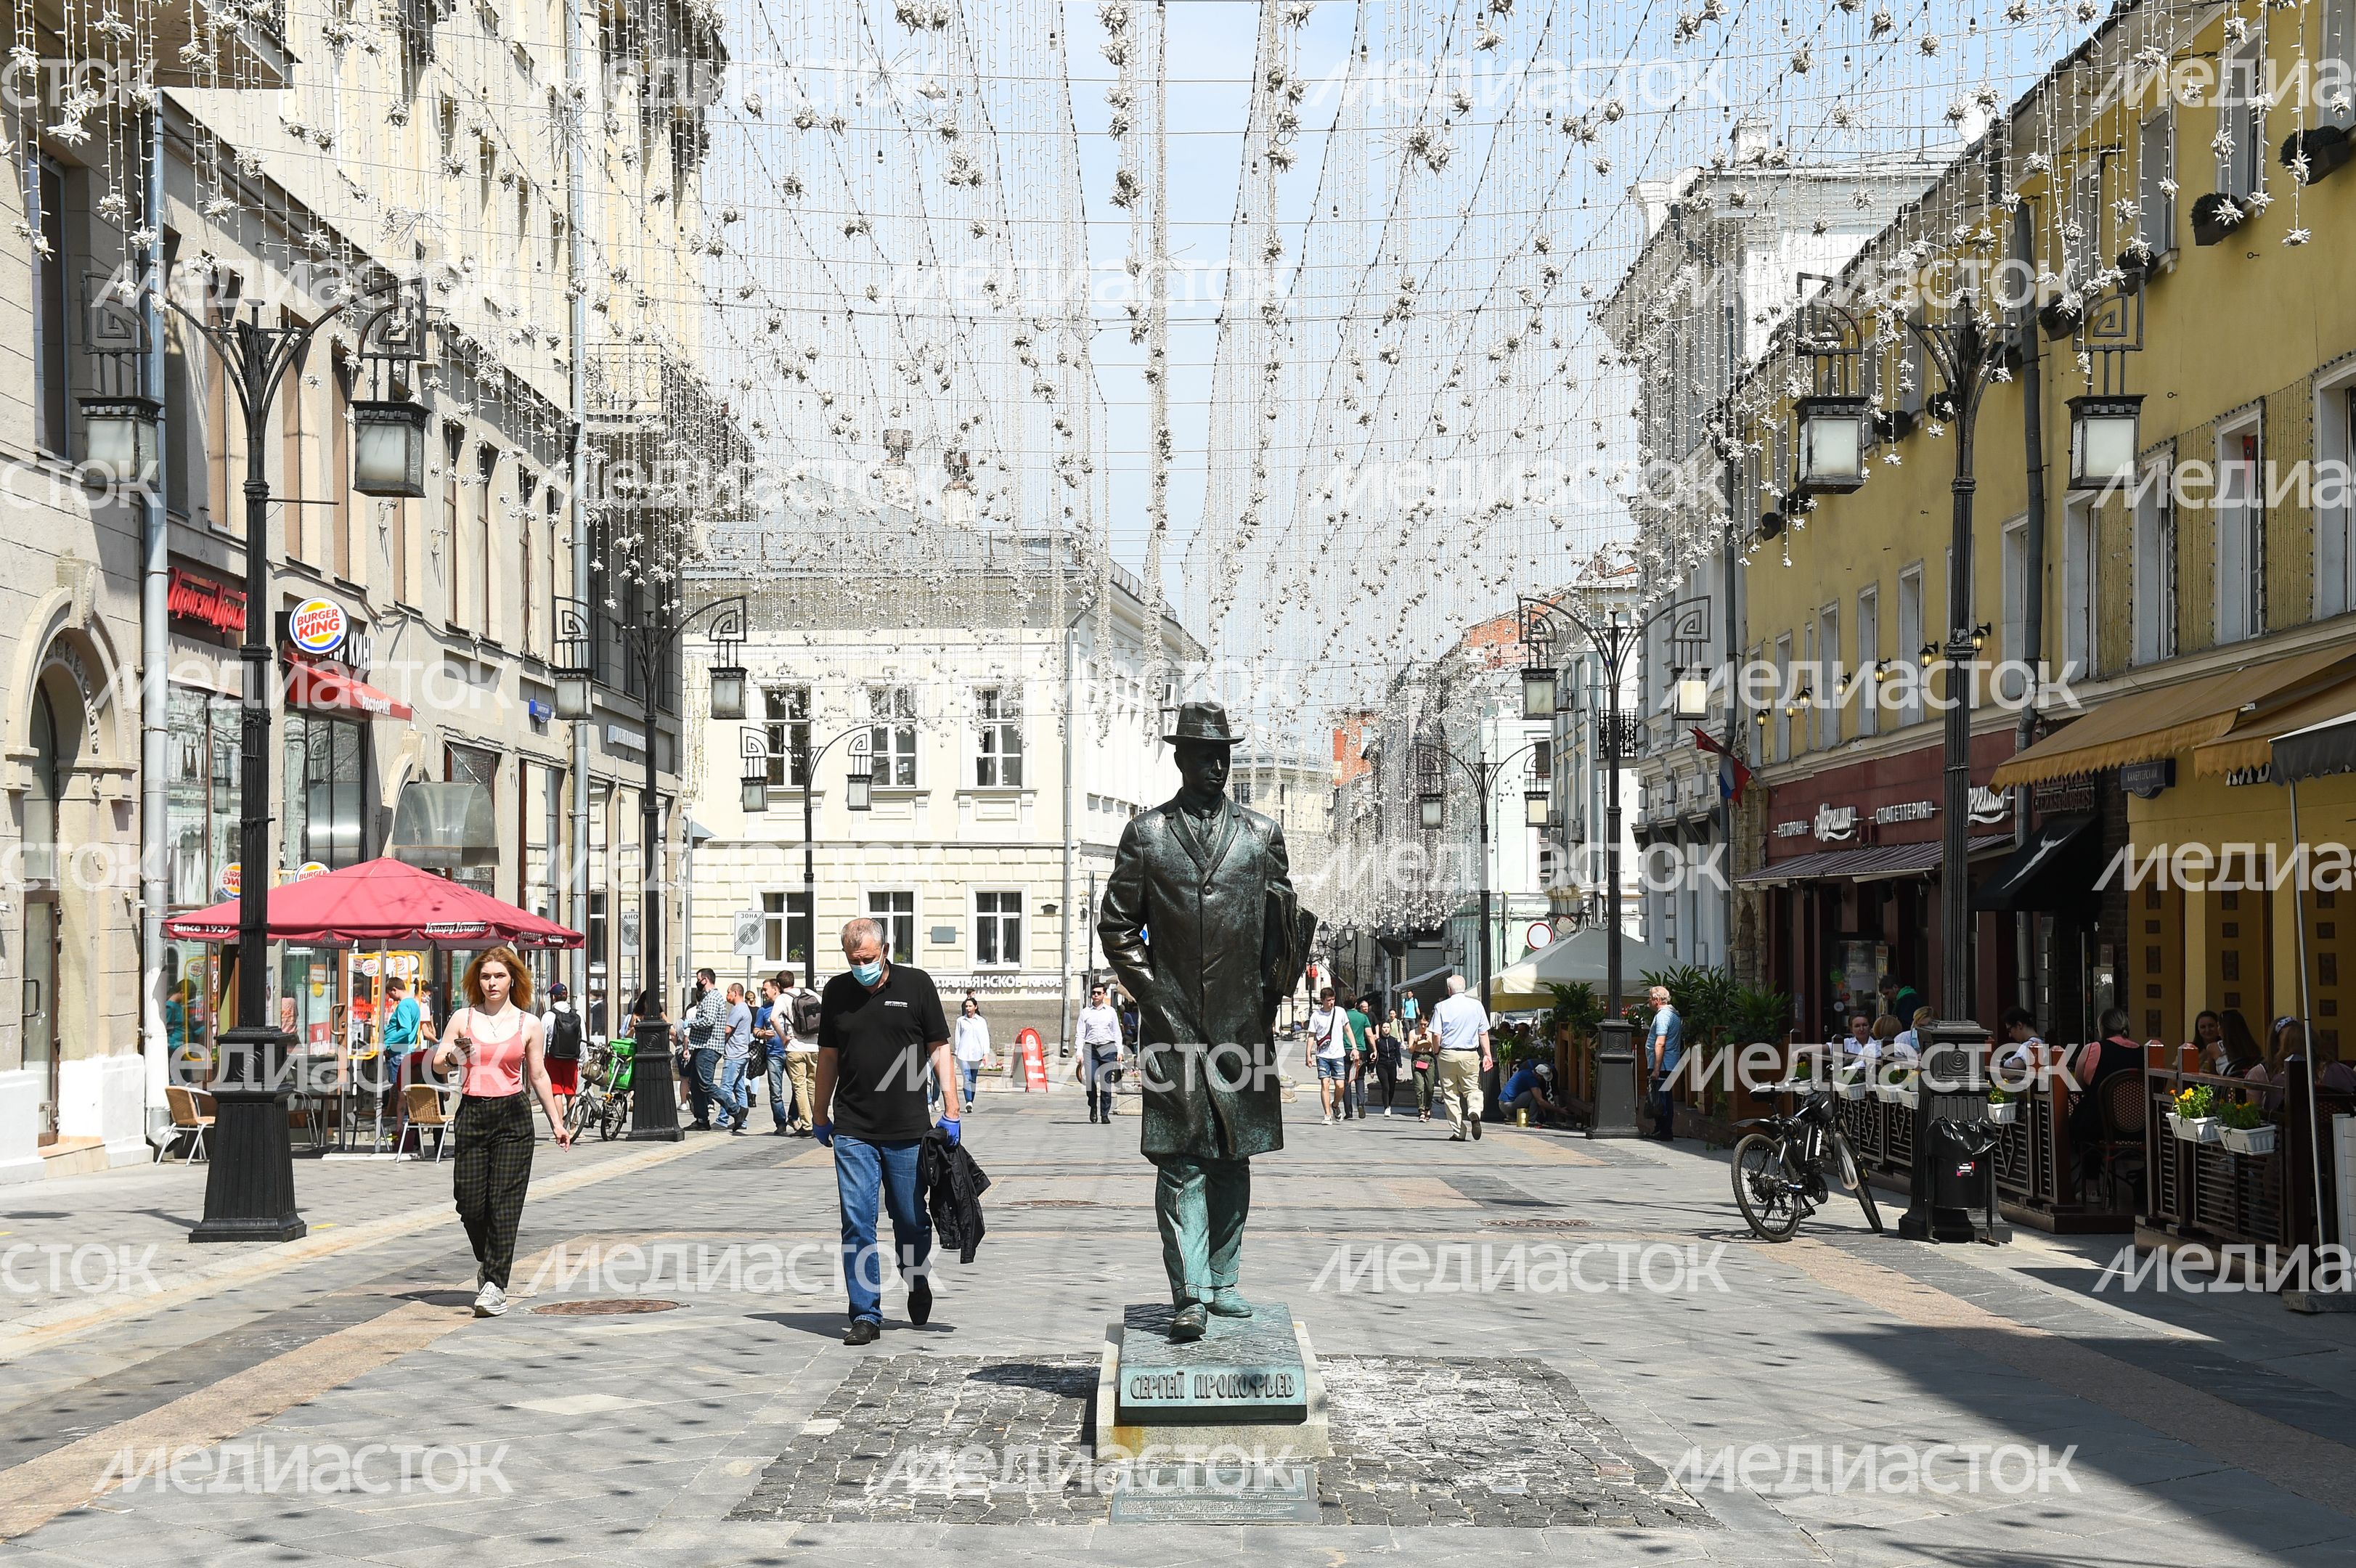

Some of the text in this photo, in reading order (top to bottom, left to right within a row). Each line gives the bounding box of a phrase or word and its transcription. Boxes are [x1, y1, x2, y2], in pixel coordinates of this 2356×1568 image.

[297, 609, 338, 626] BURGER
[298, 618, 340, 640] KING
[1777, 822, 1803, 838] РЕСТОРАН
[1875, 801, 1927, 825] СПАГЕТТЕРИЯ
[174, 923, 230, 934] Since 1937
[425, 922, 486, 935] Krispy Kreme
[1028, 975, 1063, 988] КАФЕ
[1130, 1371, 1295, 1400] СЕРГЕЙ ПРОКОФЬЕВ
